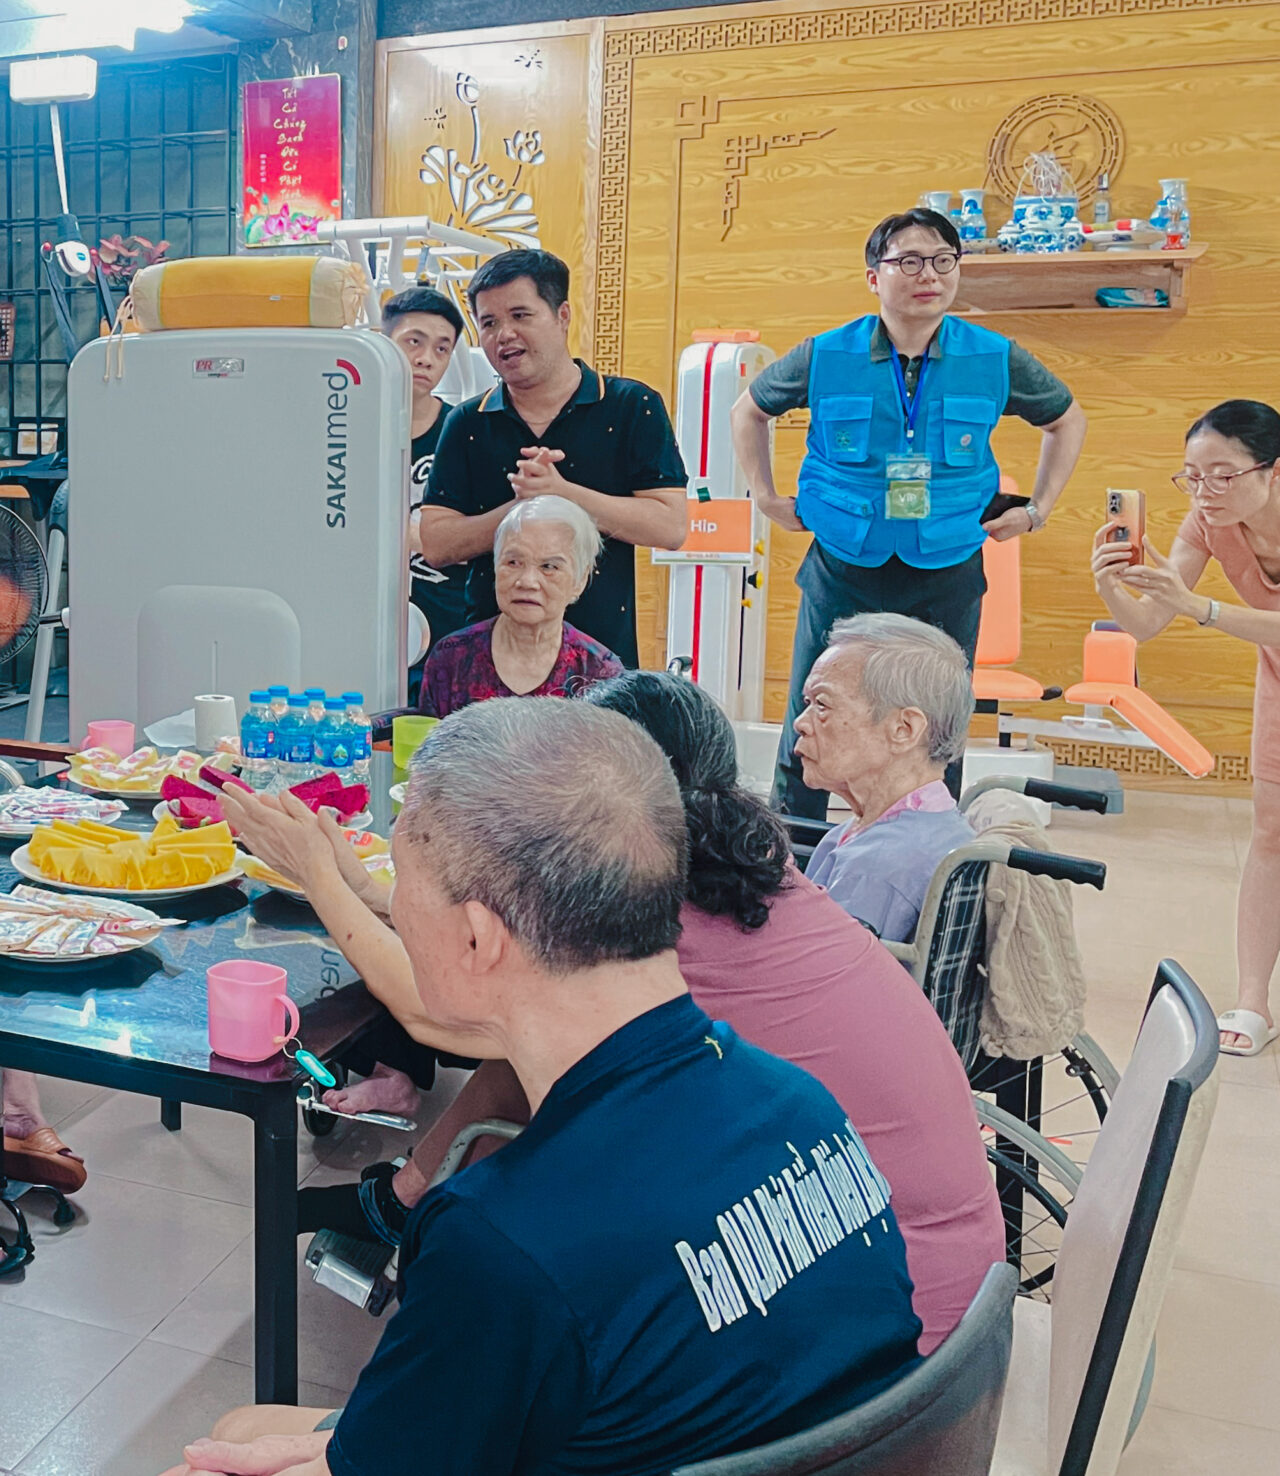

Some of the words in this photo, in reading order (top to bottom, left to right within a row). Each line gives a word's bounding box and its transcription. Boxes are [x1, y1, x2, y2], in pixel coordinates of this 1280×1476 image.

[322, 372, 349, 528] SAKAImed
[691, 519, 717, 533] Hip
[674, 1240, 749, 1333] Ban
[716, 1196, 788, 1317] QLDA
